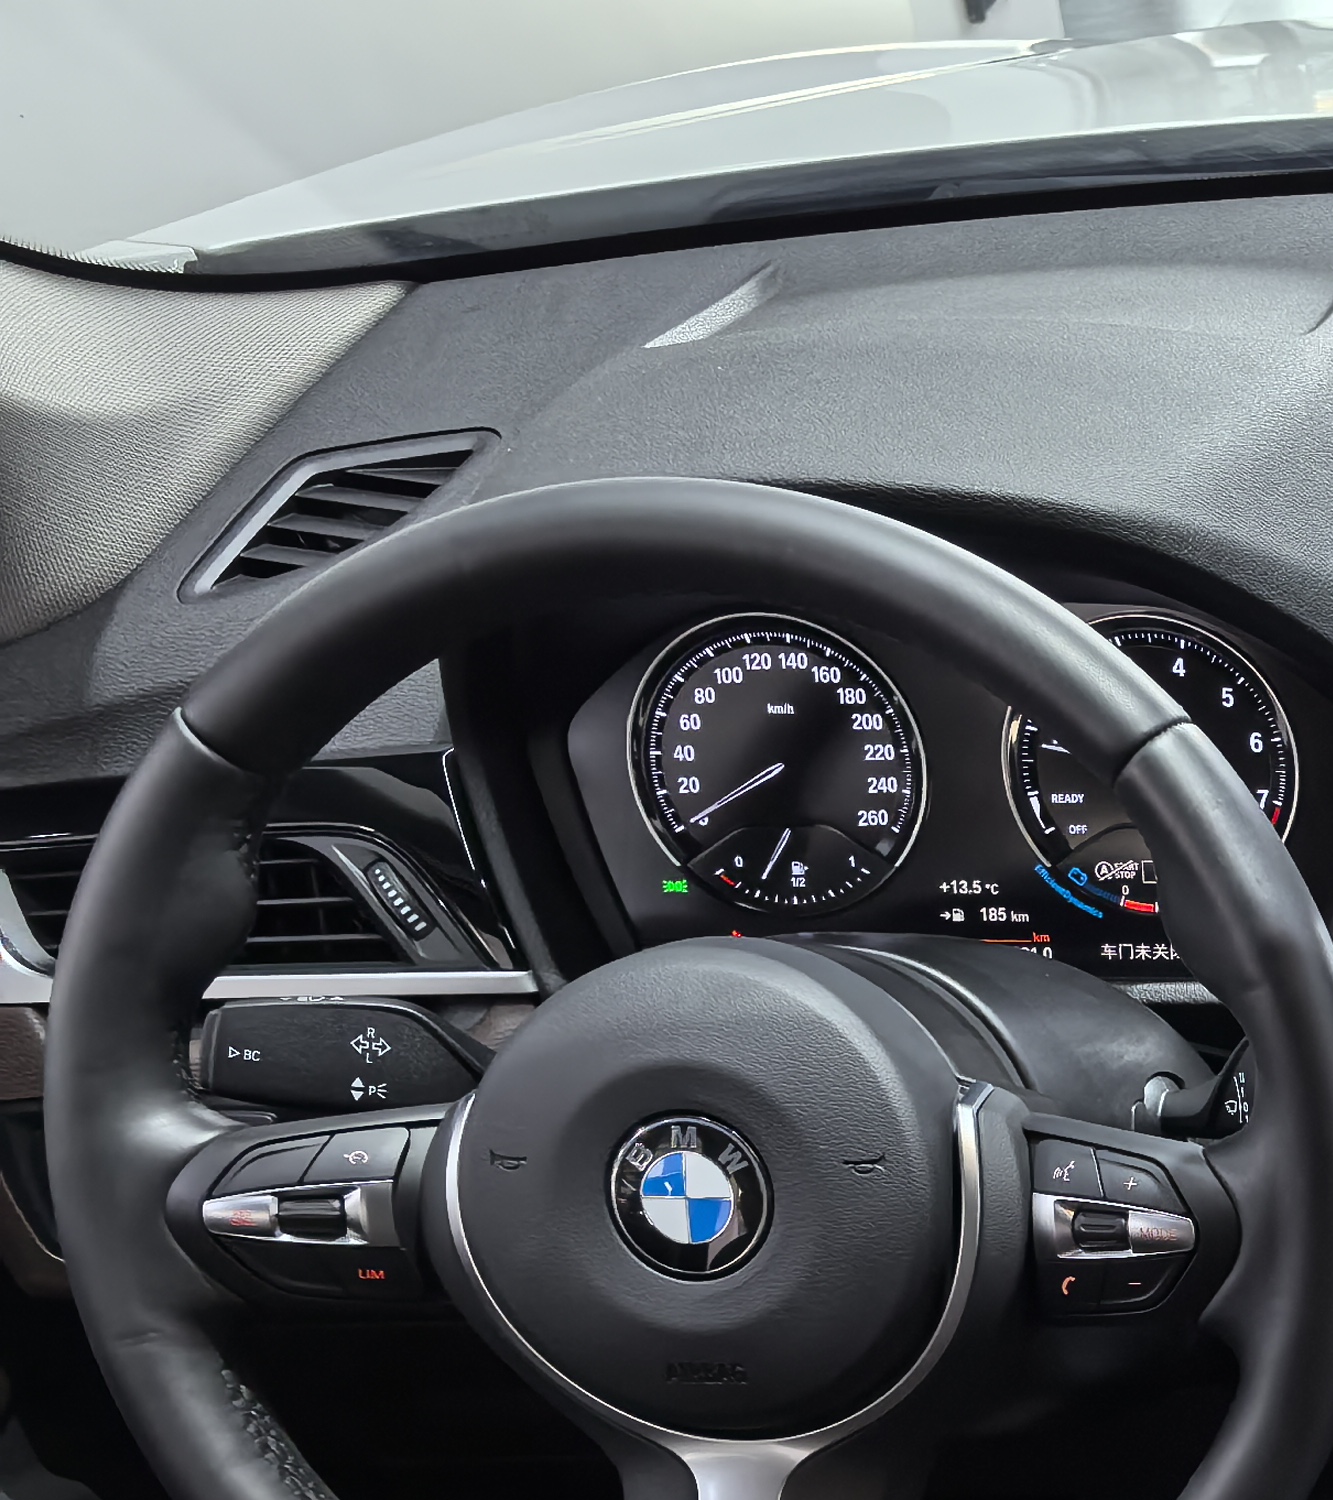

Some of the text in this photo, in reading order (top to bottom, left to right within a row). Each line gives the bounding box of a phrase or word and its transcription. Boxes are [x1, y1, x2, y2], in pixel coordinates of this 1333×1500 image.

[742, 652, 772, 671] 120
[777, 652, 808, 671] 140
[1172, 658, 1186, 677] 4
[713, 666, 743, 685] 100
[811, 665, 841, 684] 160
[694, 686, 716, 704] 80
[836, 686, 866, 705] 180
[1221, 687, 1234, 707] 5
[767, 702, 795, 716] km/h
[679, 713, 701, 731] 60
[851, 712, 883, 731] 200
[1250, 733, 1263, 753] 6
[673, 744, 695, 763] 40
[864, 743, 895, 762] 220
[678, 776, 700, 795] 20
[867, 776, 898, 795] 240
[1051, 793, 1085, 804] READY
[1256, 790, 1270, 810] 7
[857, 809, 889, 827] 260
[1068, 825, 1088, 835] OFF
[734, 855, 744, 868] 0
[848, 855, 856, 868] 1
[790, 876, 806, 888] 1/2
[938, 879, 982, 895] +13.5
[1121, 884, 1130, 896] 0
[979, 907, 1030, 922] 185 km
[1032, 931, 1051, 943] km
[367, 1027, 375, 1039] R
[243, 1050, 261, 1062] BC
[366, 1052, 373, 1064] L
[368, 1085, 377, 1096] P
[625, 1125, 748, 1173] BMW
[1139, 1227, 1178, 1241] MODE
